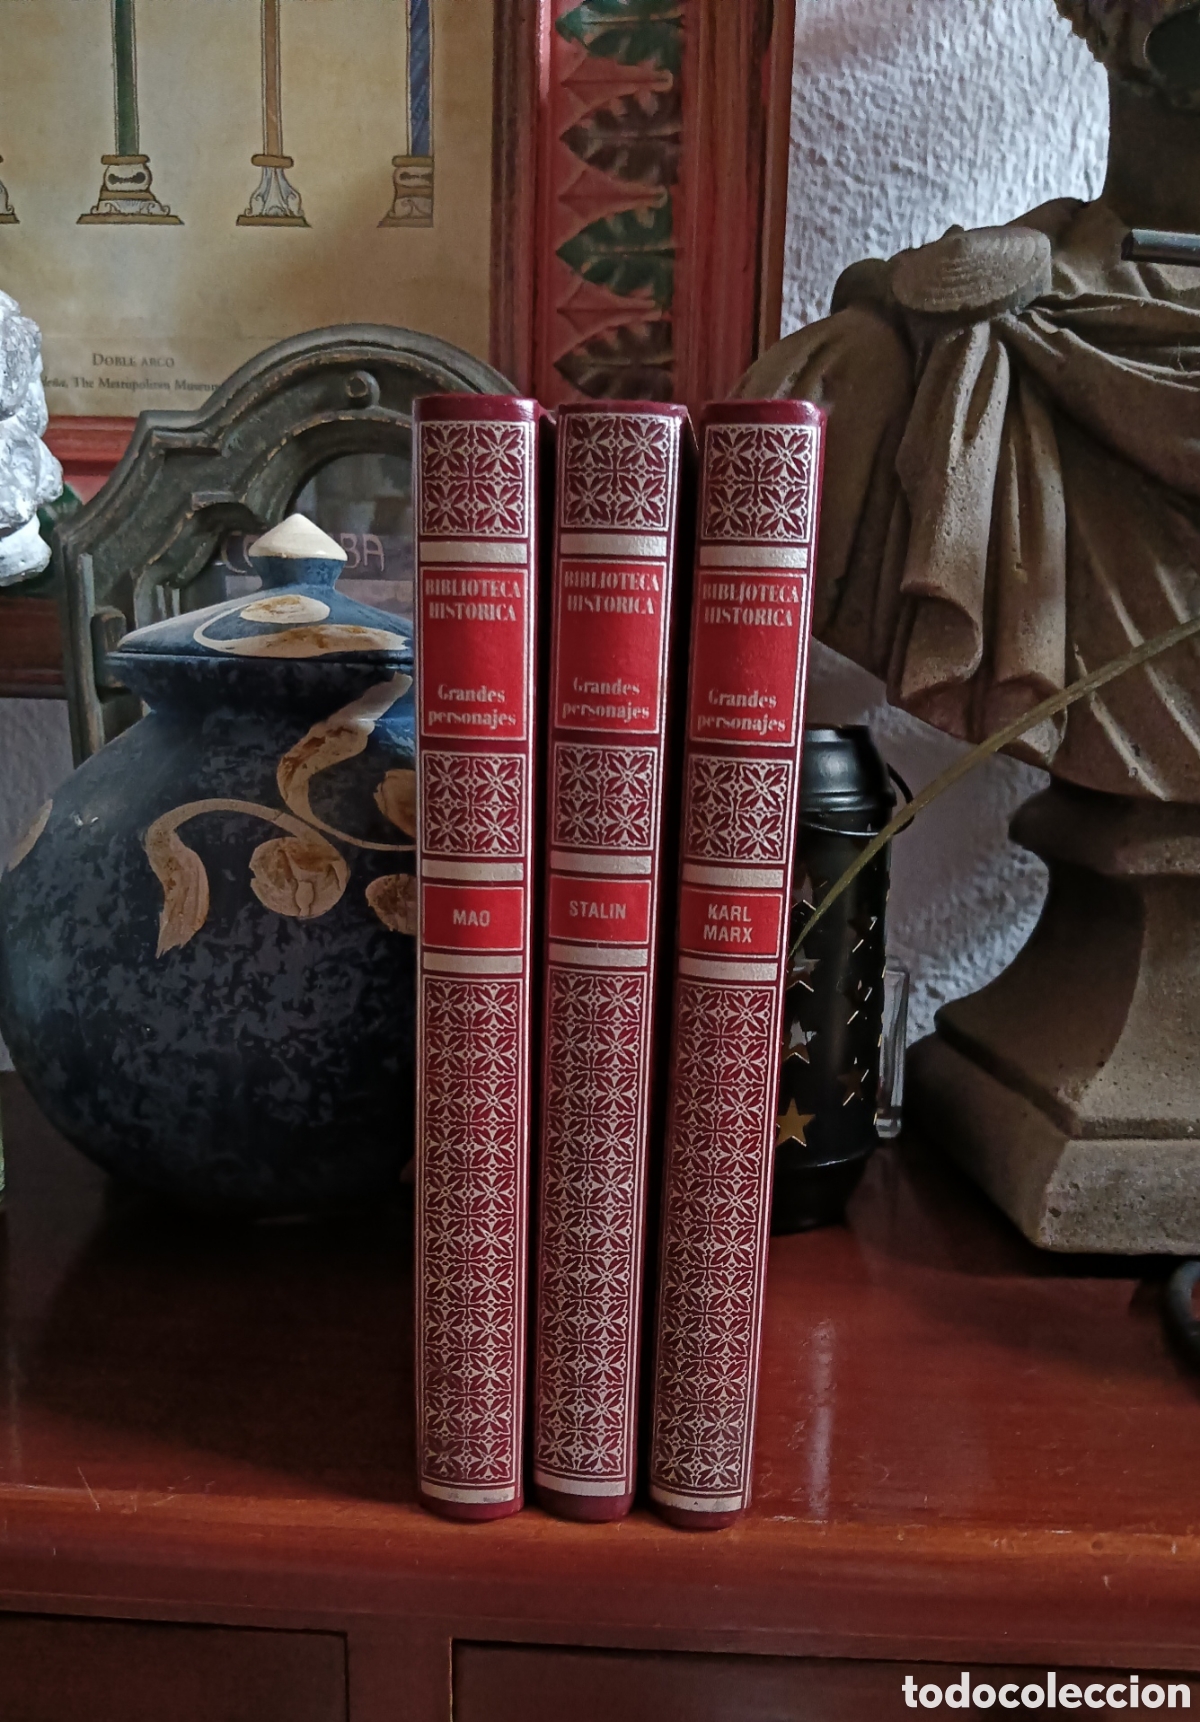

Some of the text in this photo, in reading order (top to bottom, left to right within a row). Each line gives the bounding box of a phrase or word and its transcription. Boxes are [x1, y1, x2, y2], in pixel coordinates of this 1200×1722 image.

[73, 377, 94, 389] The
[425, 579, 522, 598] BIBLIOTECA
[564, 571, 660, 592] BIBLIOTECA
[702, 583, 799, 603] BIBLIOTECA
[428, 602, 517, 622] HISTORICA
[567, 594, 654, 615] HISTORICA
[704, 607, 793, 627] HISTORICA
[437, 684, 505, 703] Grandes
[573, 677, 640, 695] Grandes
[708, 688, 777, 708] Grandes
[428, 710, 517, 730] personajes
[562, 702, 650, 723] personajes
[697, 714, 786, 736] personajes
[453, 909, 491, 927] MAO
[569, 900, 627, 920] STALIN
[707, 903, 752, 922] KARL
[703, 925, 753, 944] MARX
